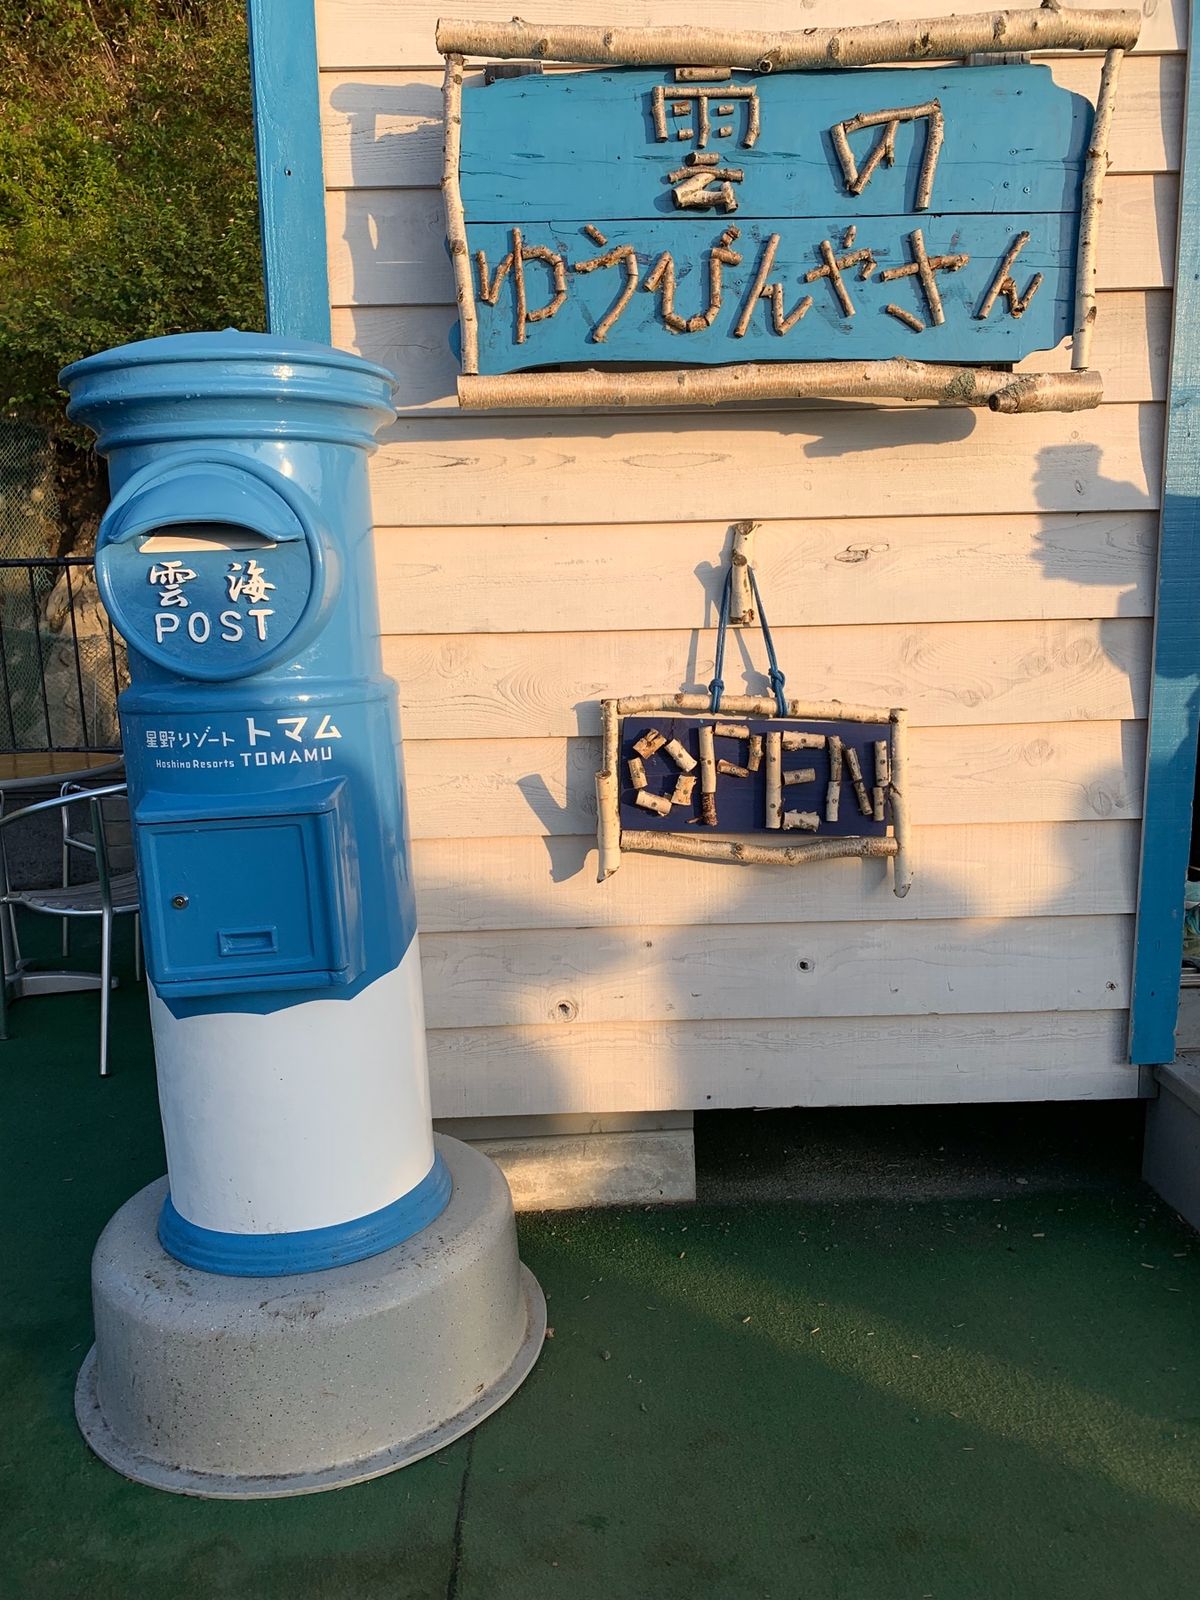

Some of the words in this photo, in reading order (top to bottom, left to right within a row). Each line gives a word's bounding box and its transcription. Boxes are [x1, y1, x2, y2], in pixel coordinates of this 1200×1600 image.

[475, 223, 1044, 345] ゆうびんやさん
[150, 560, 277, 607] 雲海
[154, 608, 275, 643] POST
[246, 715, 342, 746] トマム
[155, 759, 191, 769] Hoshino
[193, 758, 235, 769] Resorts
[240, 746, 332, 767] TOMAMU
[627, 721, 886, 832] OPEN
